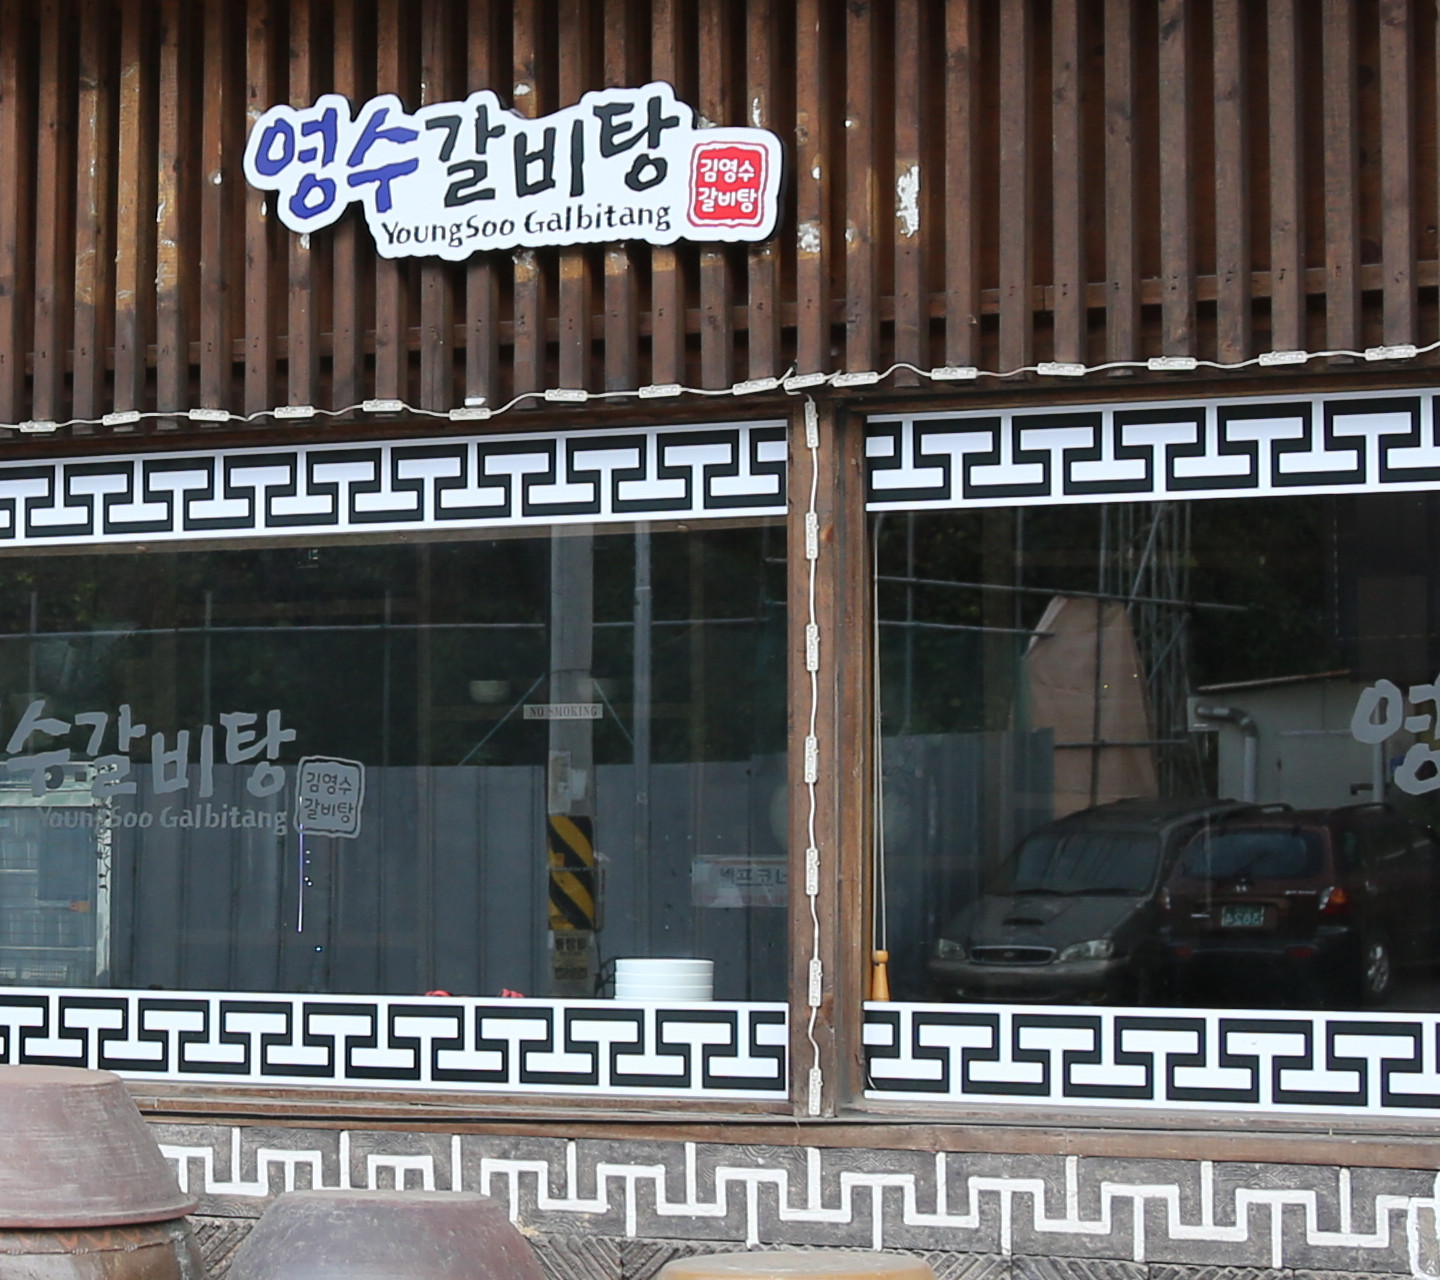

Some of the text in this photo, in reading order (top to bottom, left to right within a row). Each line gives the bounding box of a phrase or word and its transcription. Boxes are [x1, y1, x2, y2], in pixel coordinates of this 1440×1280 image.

[255, 97, 680, 218] 영수갈비탕
[700, 158, 756, 183] 김영수
[698, 187, 758, 213] 갈비탕
[381, 204, 672, 248] YoungSoo Galbitang
[305, 770, 353, 795] 김영수
[303, 797, 355, 820] 갈비탕
